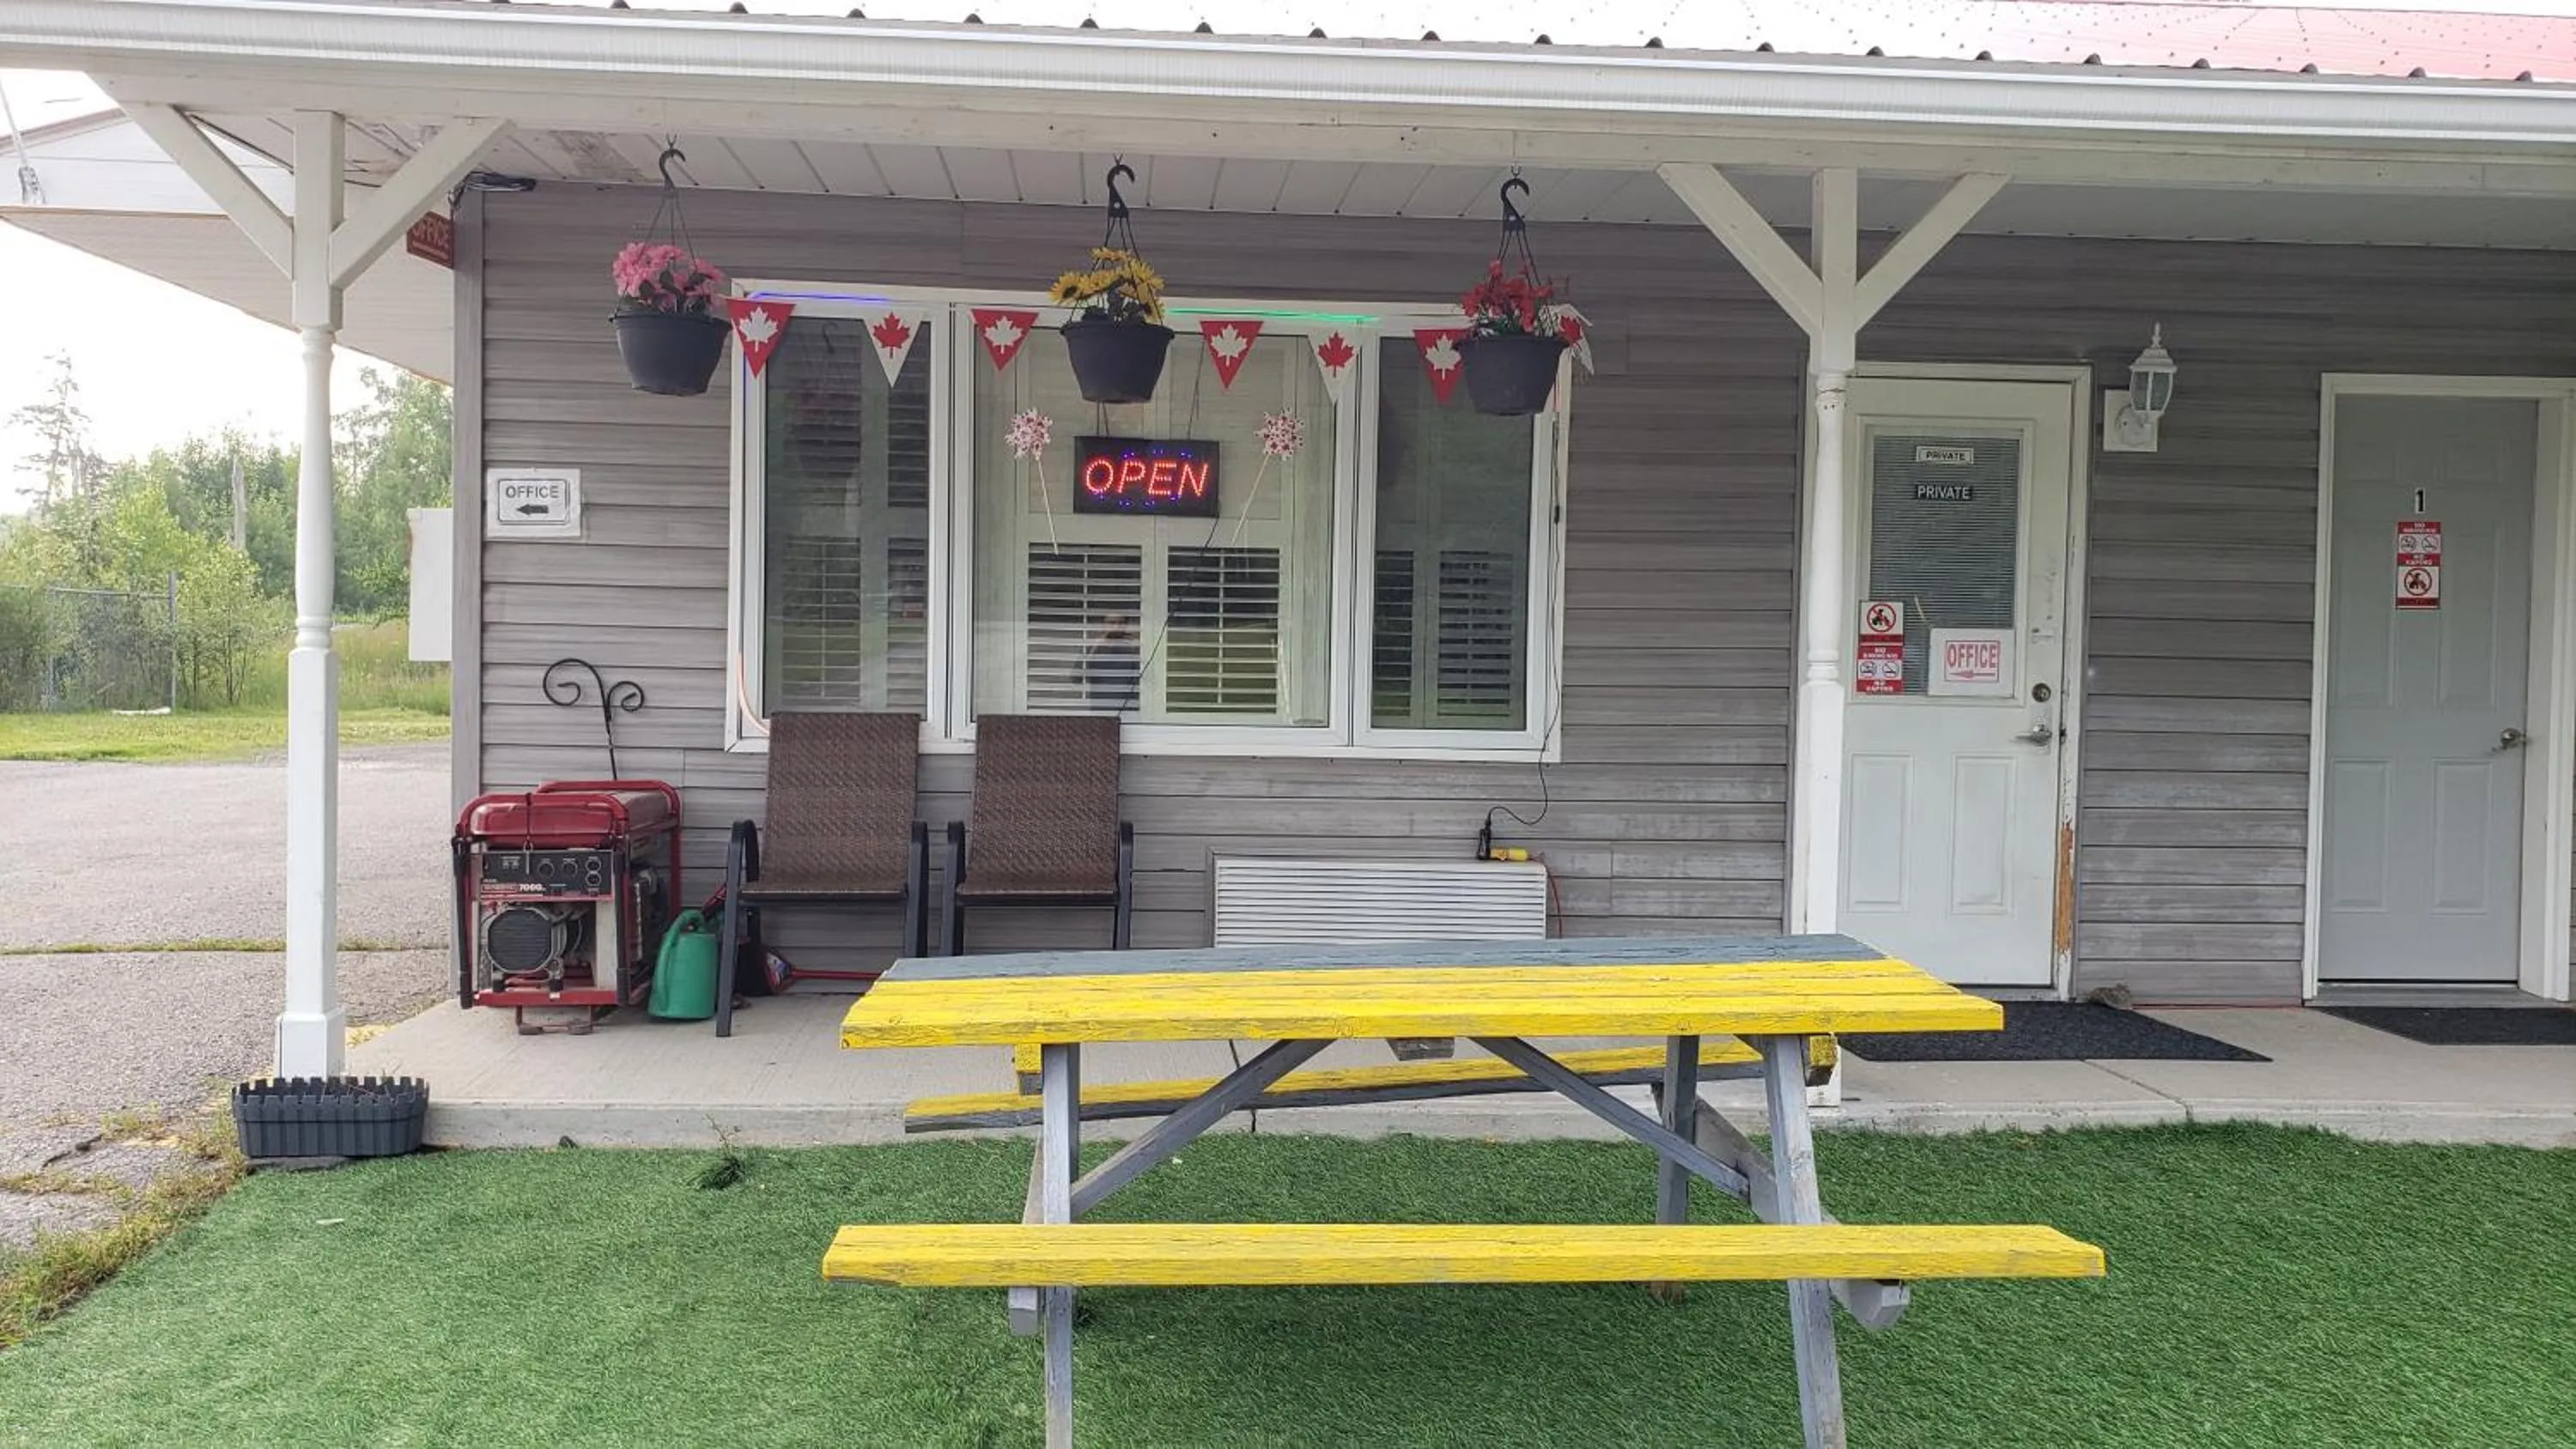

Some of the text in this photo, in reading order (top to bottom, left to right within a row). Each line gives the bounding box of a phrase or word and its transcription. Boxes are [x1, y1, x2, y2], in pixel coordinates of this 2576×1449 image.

[1926, 451, 1965, 461] PRIVATE
[1085, 459, 1209, 498] OPEN
[506, 485, 559, 498] OFFICE
[1917, 485, 1971, 500] PRIVATE
[2415, 488, 2424, 512] 1
[1947, 644, 1996, 668] OFFICE
